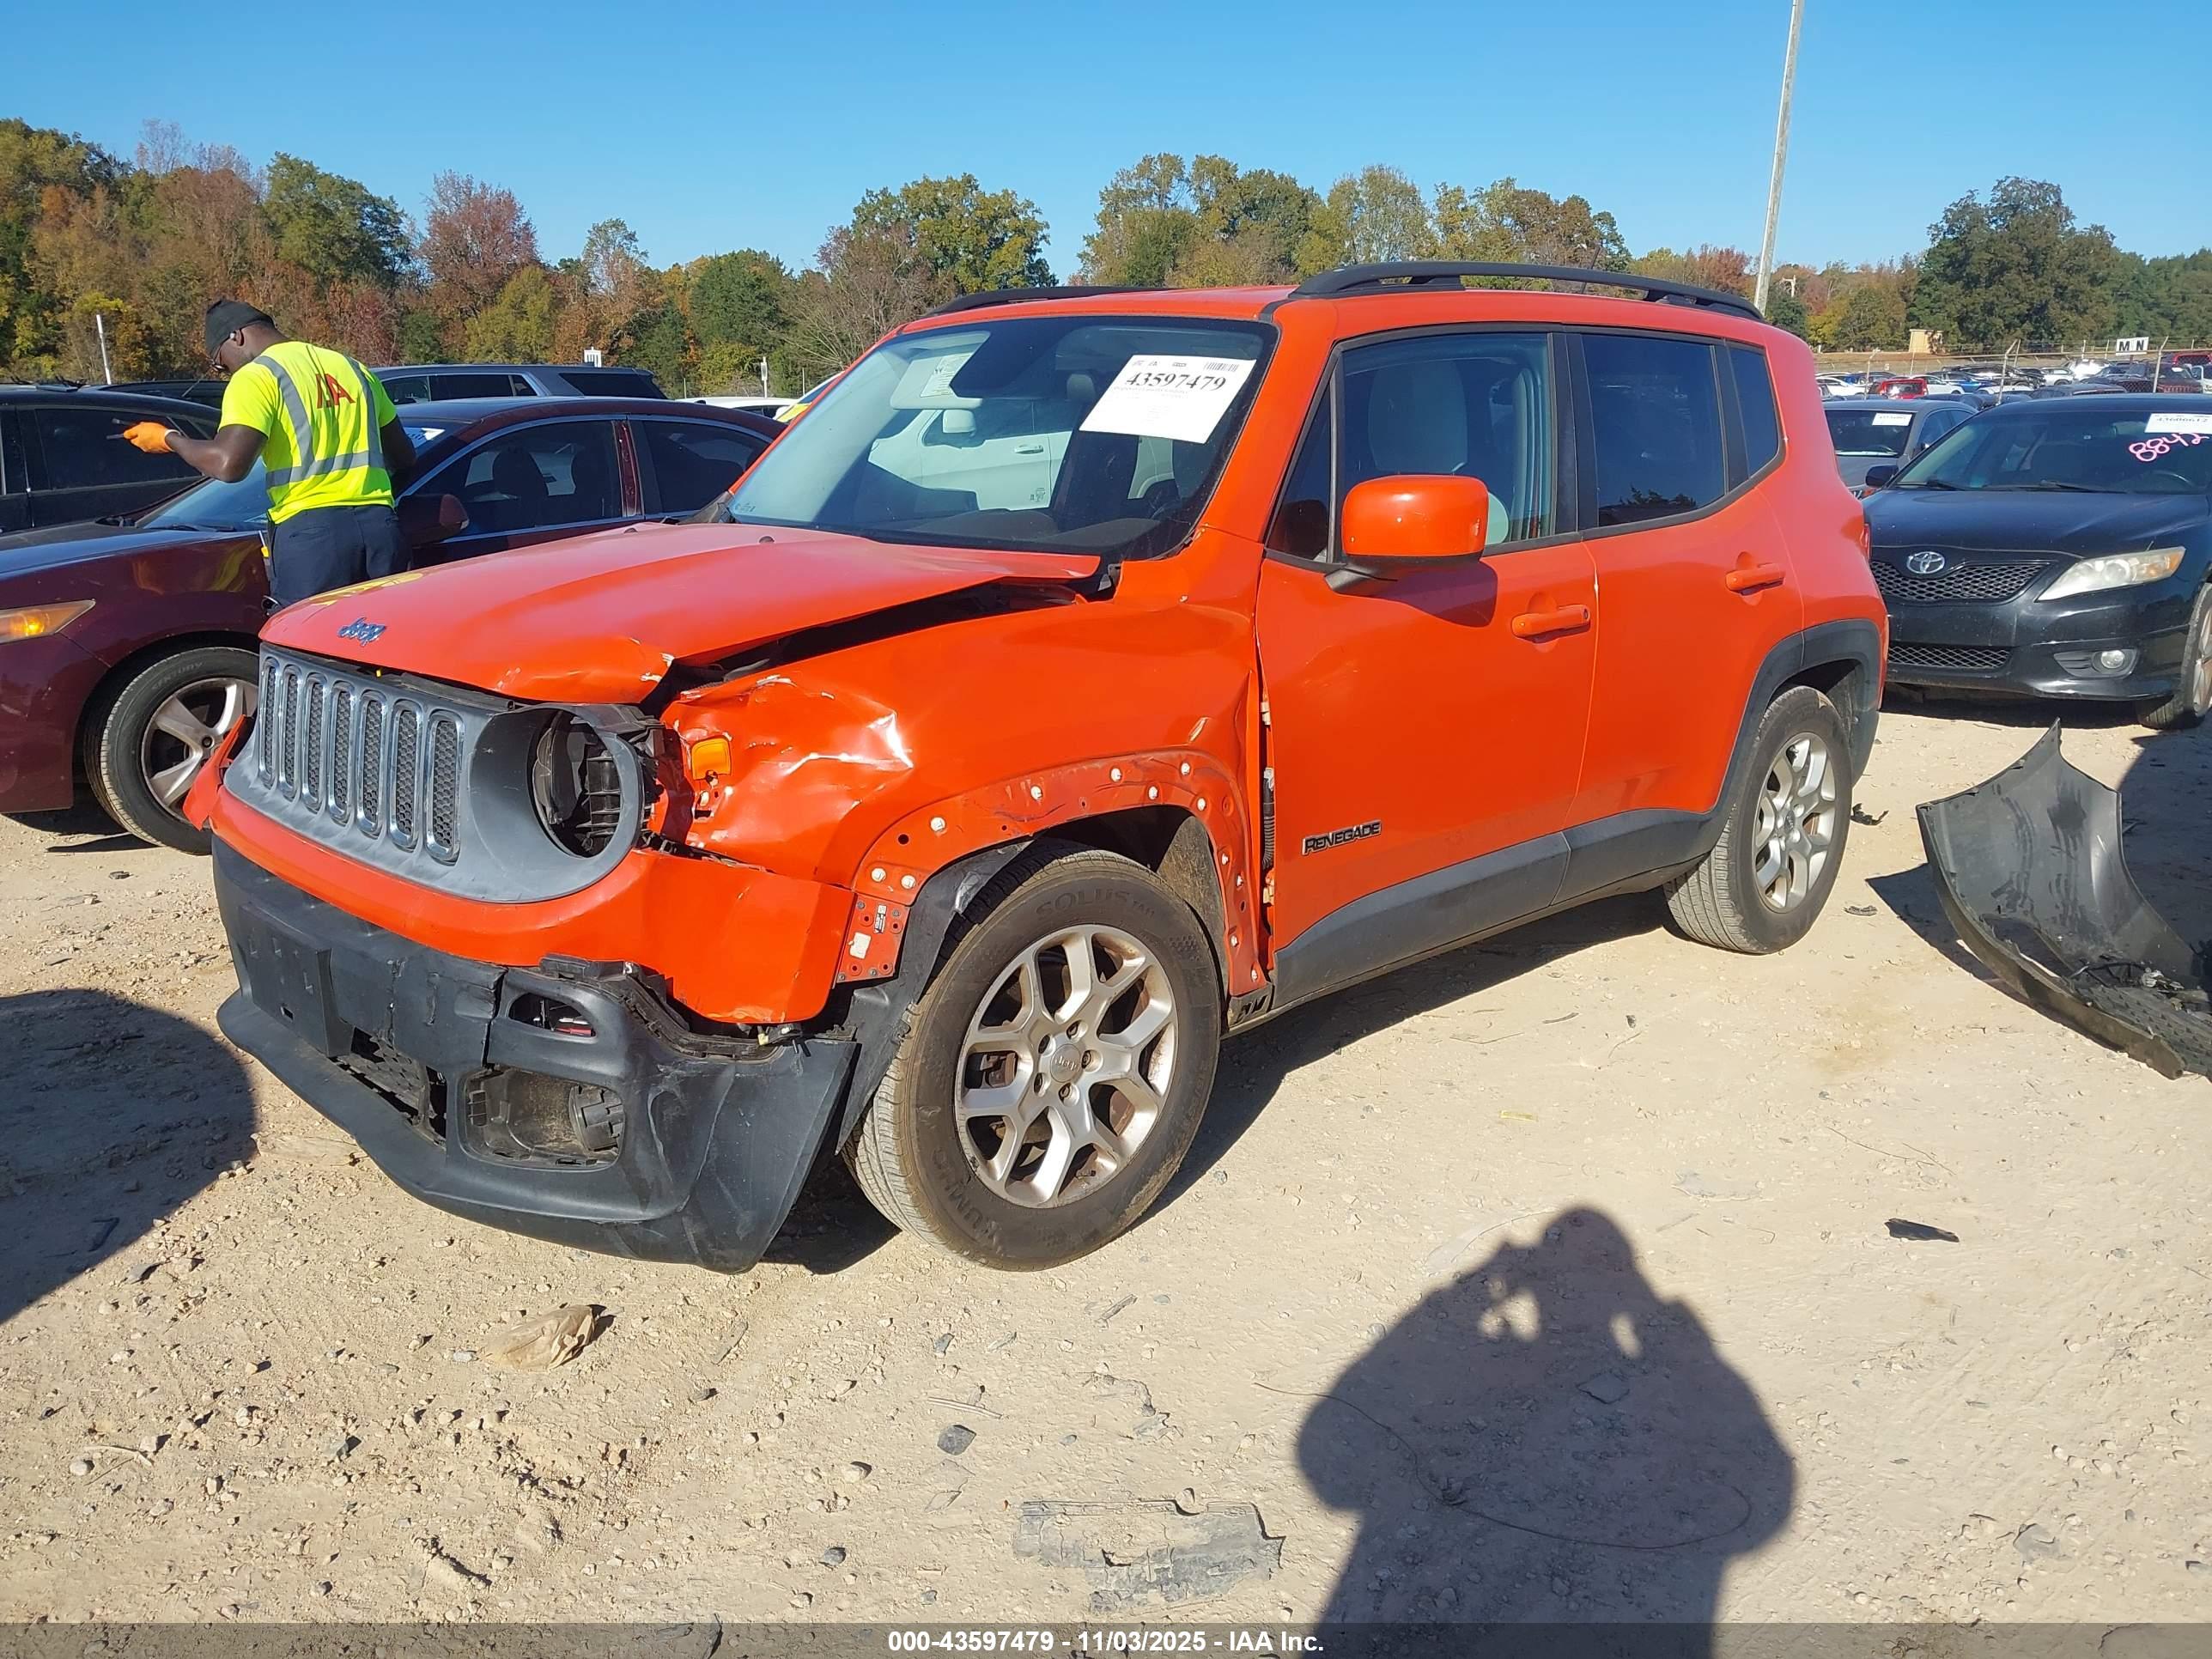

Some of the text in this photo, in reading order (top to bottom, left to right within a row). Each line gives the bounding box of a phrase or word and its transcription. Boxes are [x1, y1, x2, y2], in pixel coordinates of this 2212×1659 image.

[2119, 339, 2144, 350] M N
[1125, 372, 1226, 392] 43597479
[2129, 432, 2209, 462] 8842
[1302, 819, 1382, 855] RENEGADE
